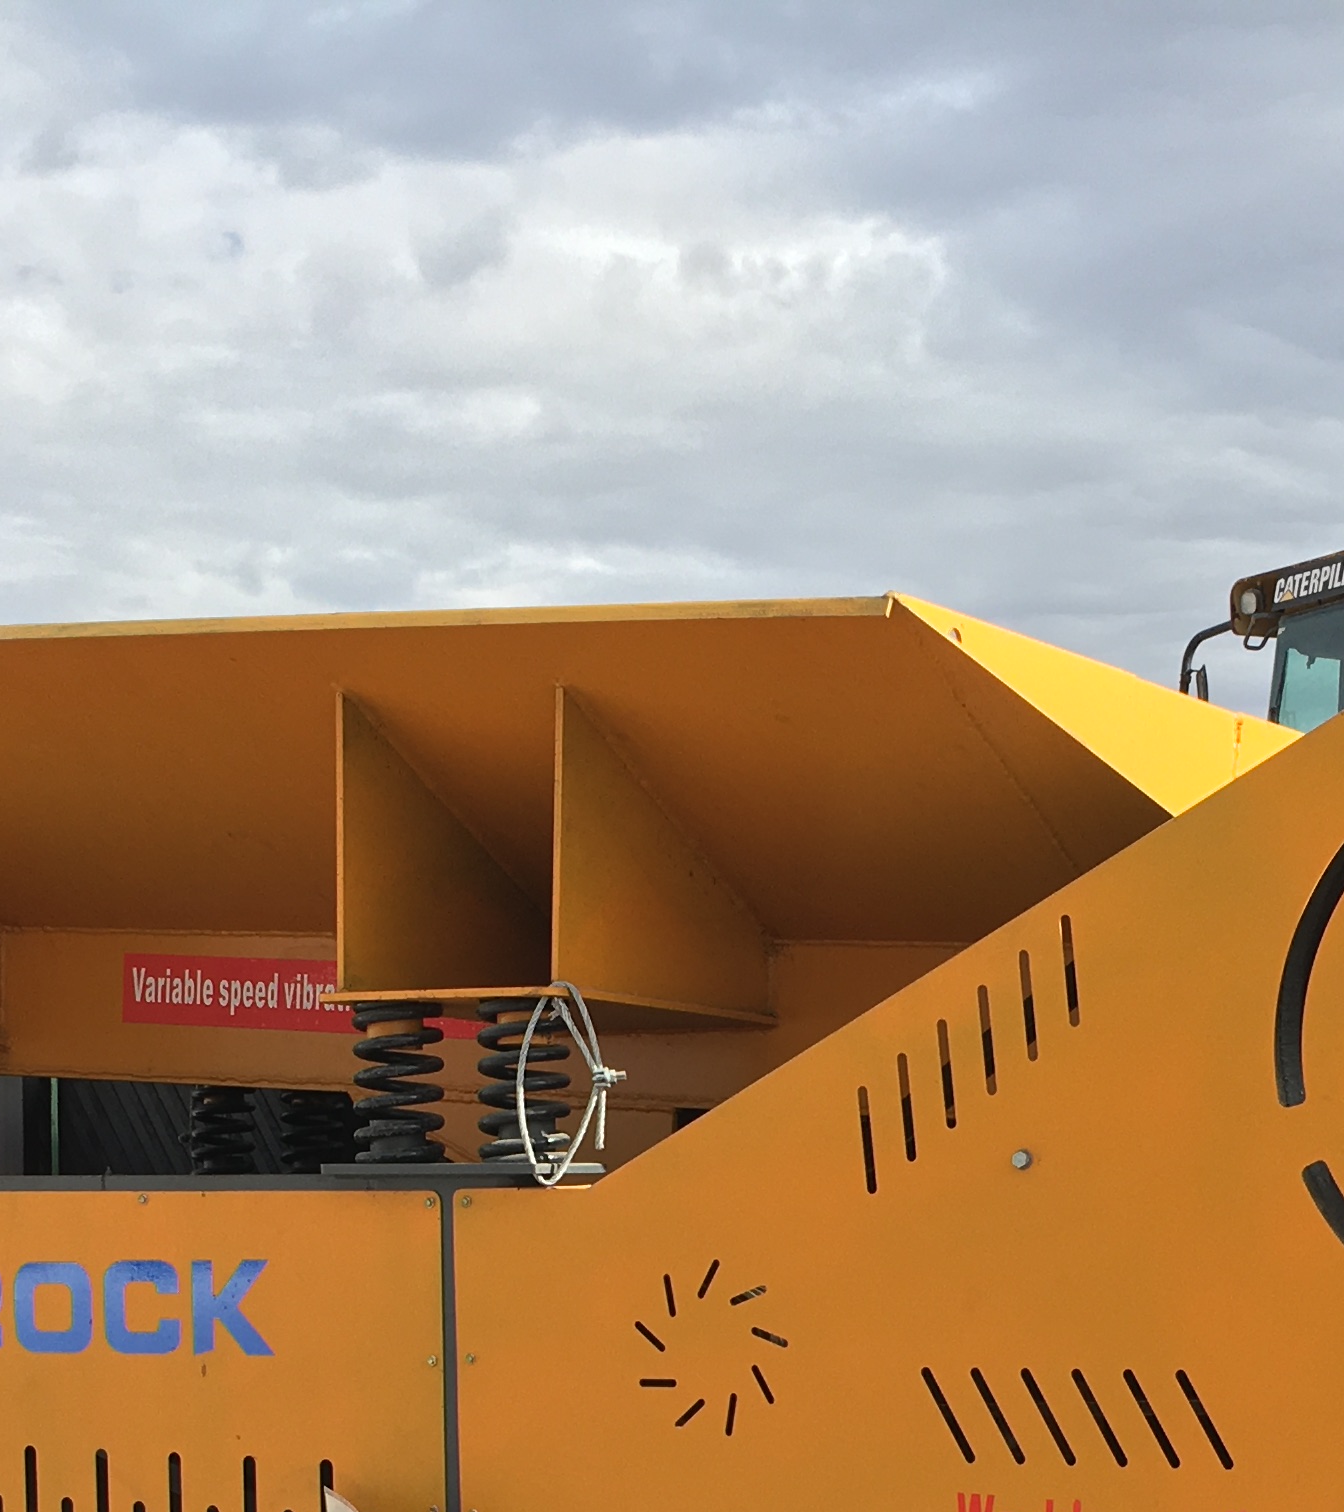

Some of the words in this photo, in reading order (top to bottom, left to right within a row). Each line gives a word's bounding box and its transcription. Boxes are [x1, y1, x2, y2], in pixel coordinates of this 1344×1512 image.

[132, 966, 214, 1006] Variable
[219, 972, 279, 1016] speed
[284, 973, 350, 1011] vibra
